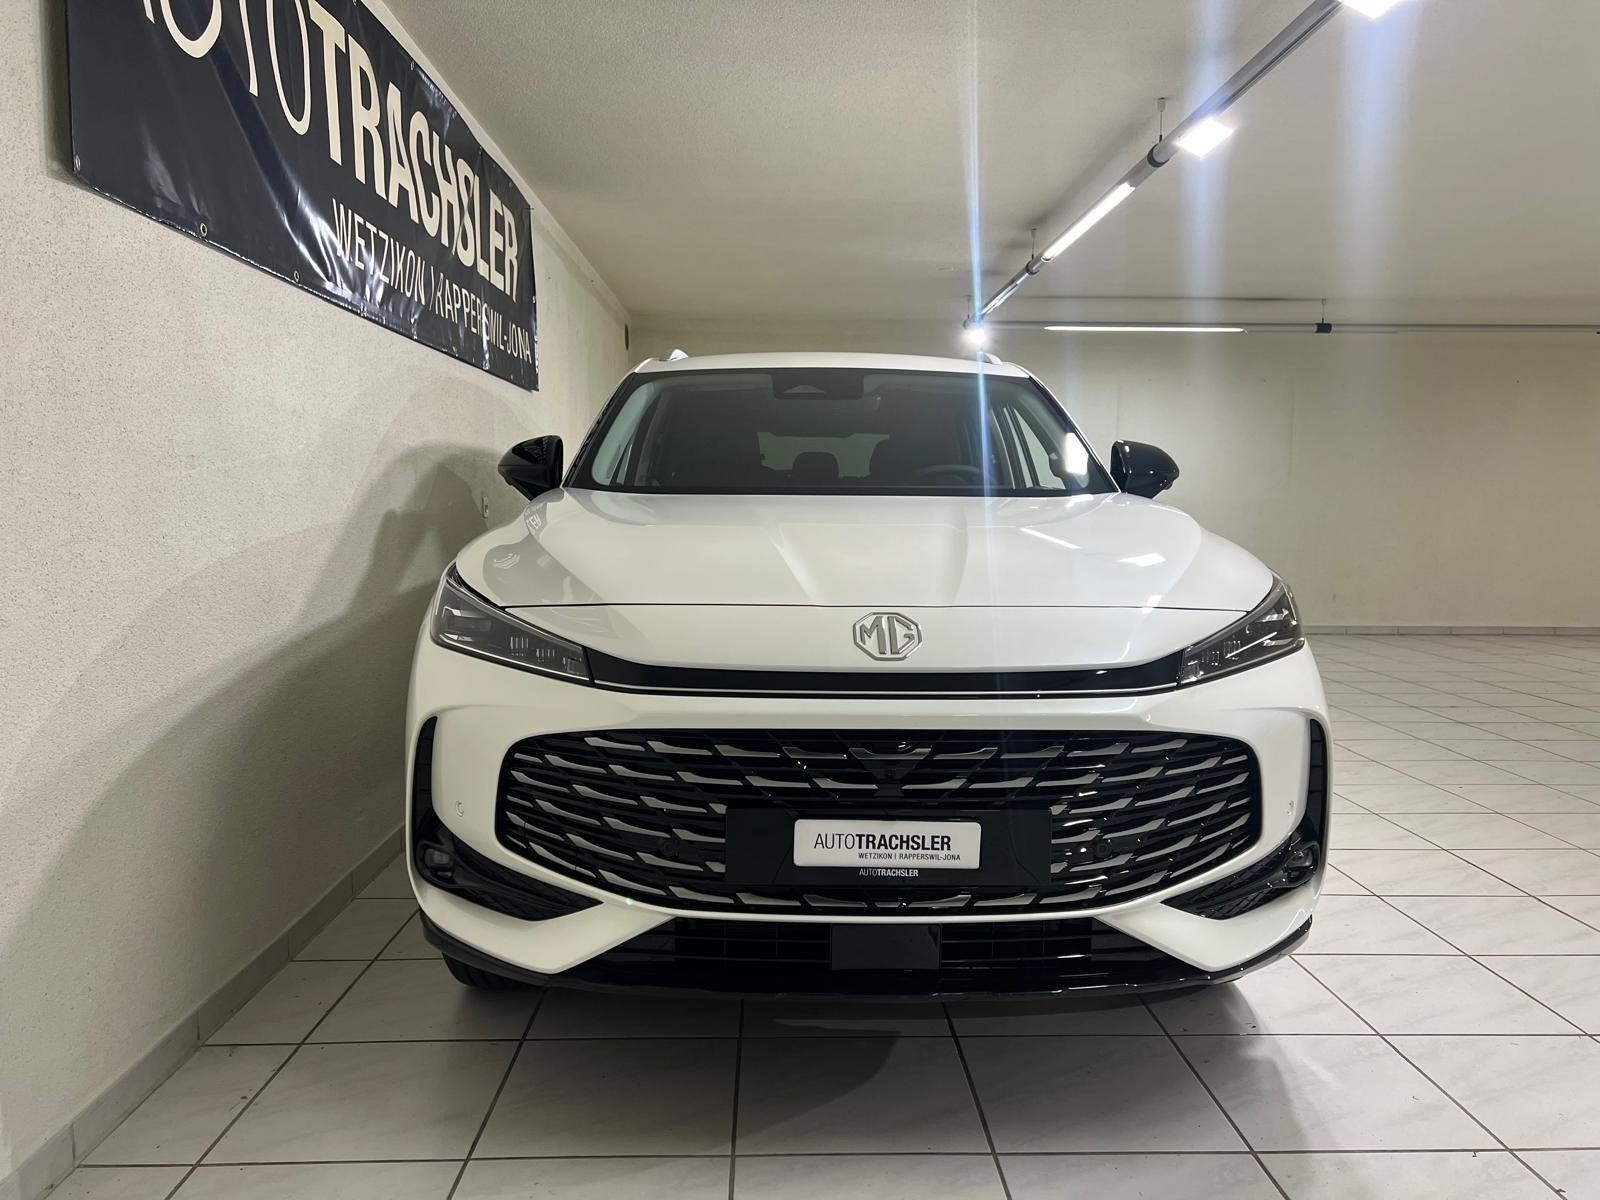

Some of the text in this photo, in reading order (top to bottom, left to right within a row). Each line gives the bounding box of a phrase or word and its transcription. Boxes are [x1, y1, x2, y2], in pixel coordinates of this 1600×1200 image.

[332, 198, 425, 305] WETZIKON
[435, 272, 532, 364] RAPPERSWIL-JONA
[859, 615, 915, 655] MG
[813, 833, 952, 851] AUTOTRACHSLER
[858, 852, 893, 860] WETZIKON
[899, 853, 961, 861] RAPPERSWIL-JONA
[859, 868, 919, 877] AUTOTRACHSLER
